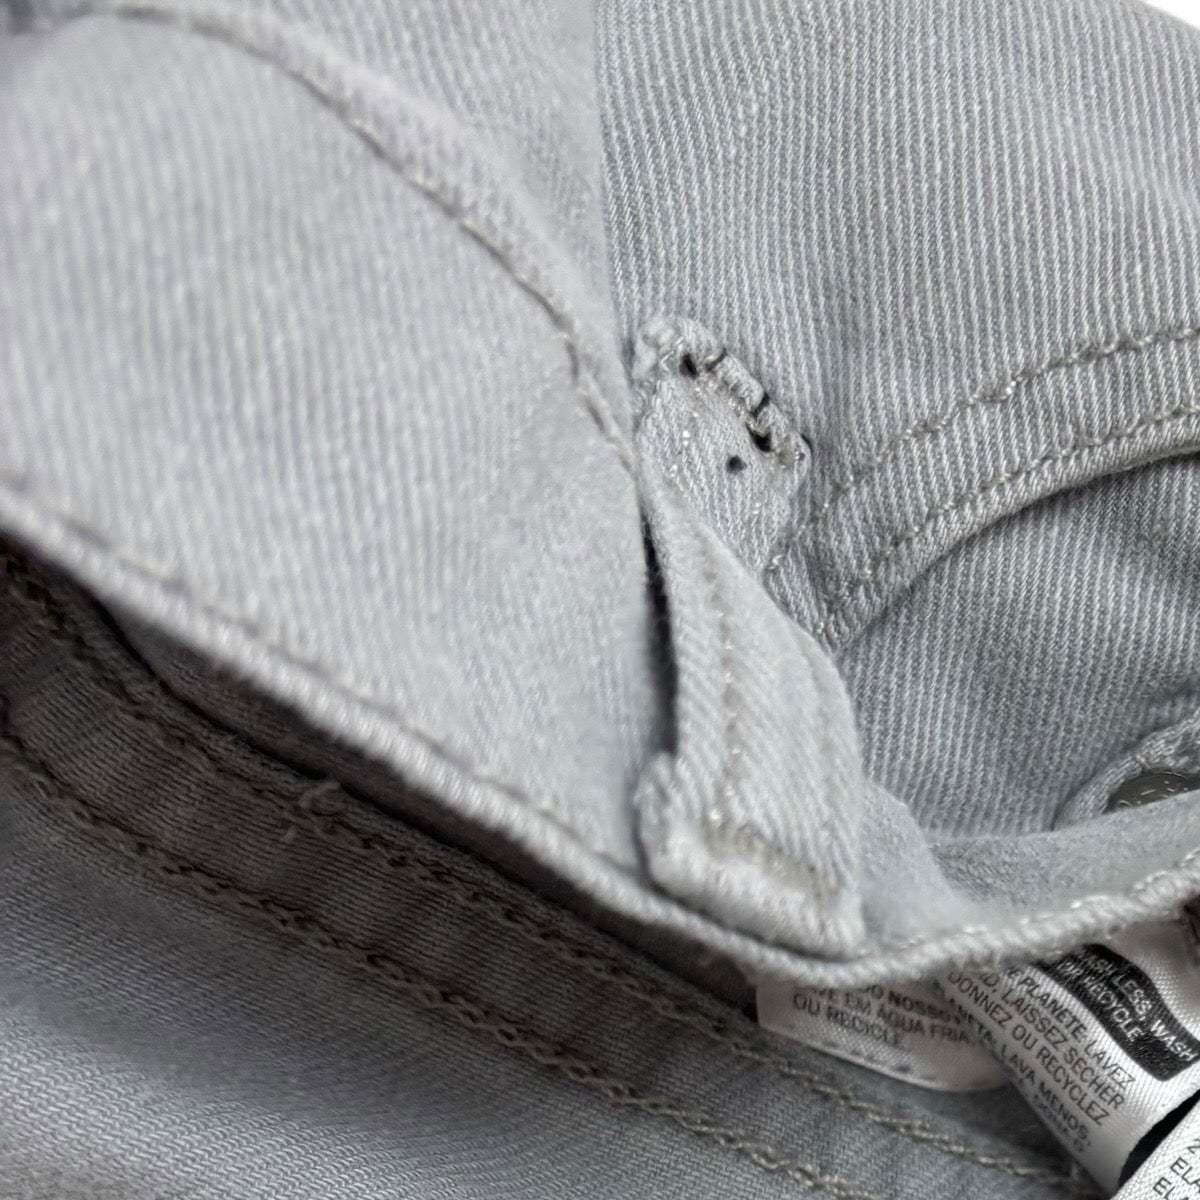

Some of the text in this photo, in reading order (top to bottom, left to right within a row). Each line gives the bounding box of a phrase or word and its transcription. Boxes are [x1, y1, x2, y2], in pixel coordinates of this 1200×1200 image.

[1001, 985, 1069, 1050] LAISSEZ
[1064, 1049, 1125, 1110] SECHER
[1012, 1023, 1038, 1052] OU
[1036, 1046, 1111, 1127] RECYCLEZ
[1085, 1040, 1136, 1092] LAVEZ
